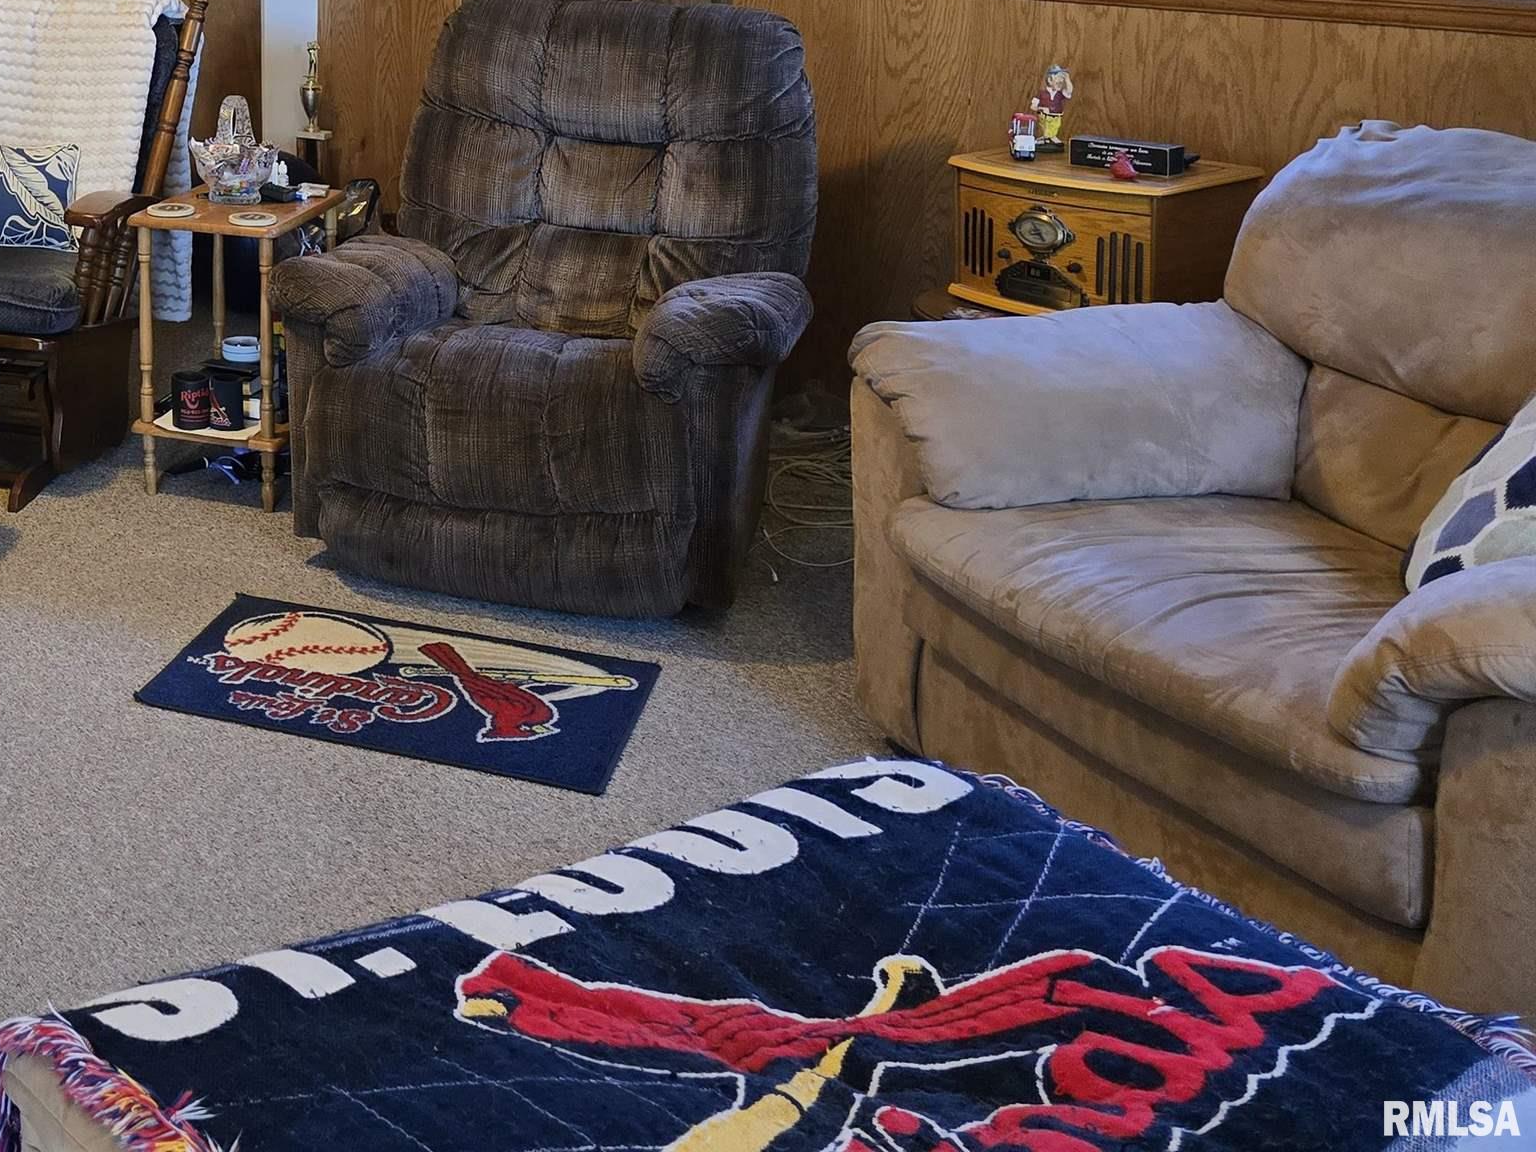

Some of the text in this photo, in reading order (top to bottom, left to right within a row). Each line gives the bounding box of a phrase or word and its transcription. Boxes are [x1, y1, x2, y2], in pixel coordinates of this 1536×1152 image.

[205, 652, 457, 723] Cardinals
[229, 690, 375, 734] St. Louis
